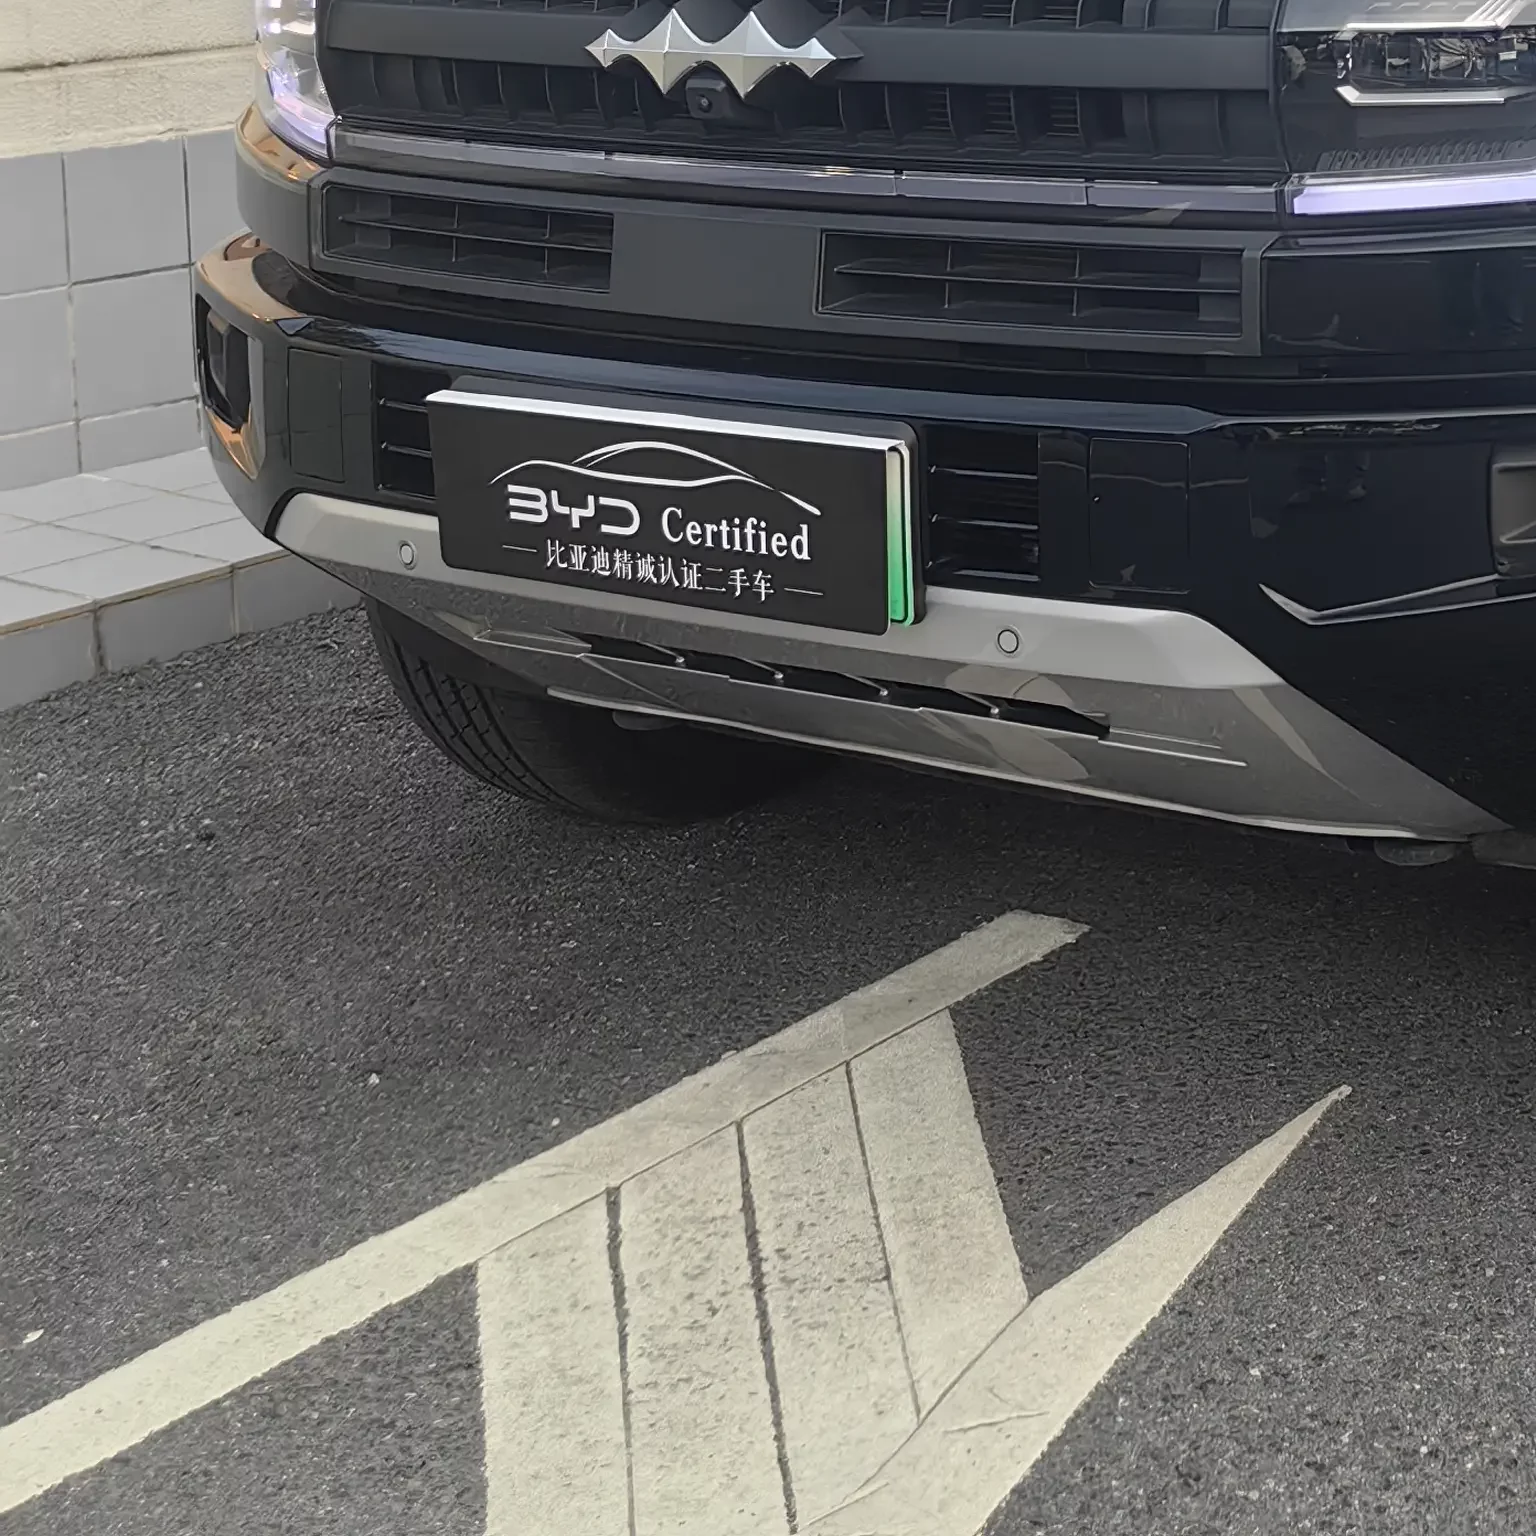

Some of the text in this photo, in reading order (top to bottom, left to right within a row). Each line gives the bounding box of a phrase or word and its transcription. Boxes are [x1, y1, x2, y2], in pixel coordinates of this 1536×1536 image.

[506, 483, 813, 561] BYD Certified
[545, 538, 776, 602] 比亚迪精诚认证二手车
